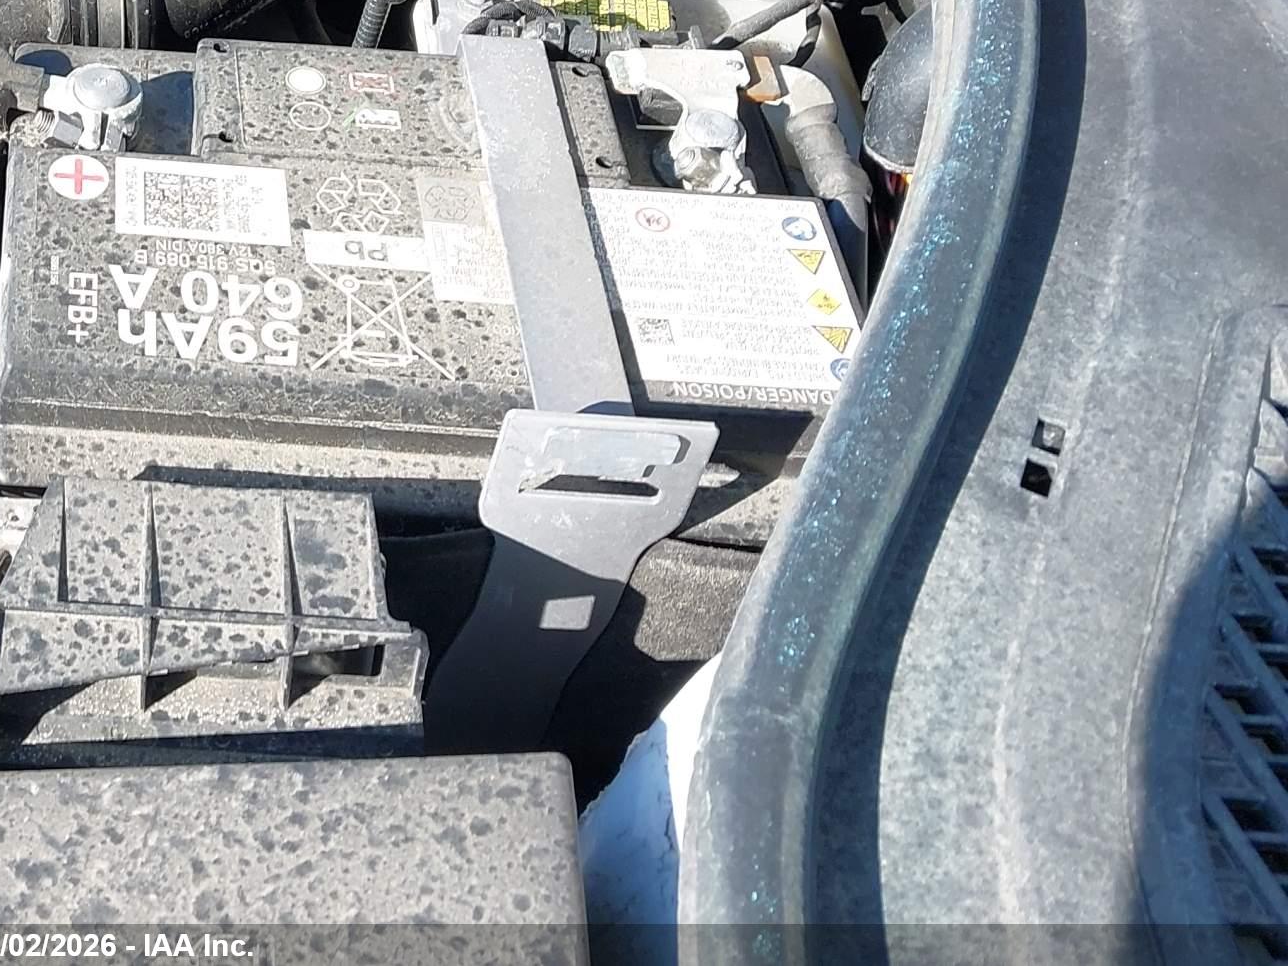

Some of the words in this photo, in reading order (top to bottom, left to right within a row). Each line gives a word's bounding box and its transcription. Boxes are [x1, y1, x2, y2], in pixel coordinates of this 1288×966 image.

[134, 248, 149, 264] B
[156, 239, 183, 253] DIN
[185, 241, 225, 256] 380A
[227, 244, 252, 258] 12V
[343, 238, 389, 263] Pb
[155, 251, 190, 270] 089
[195, 253, 227, 272] 915
[234, 255, 276, 275] 5QS
[107, 263, 159, 310] A
[180, 269, 304, 321] 640
[68, 271, 99, 344] EFB+
[116, 307, 300, 367] 59Ah
[671, 380, 834, 406] DANGER/POISON
